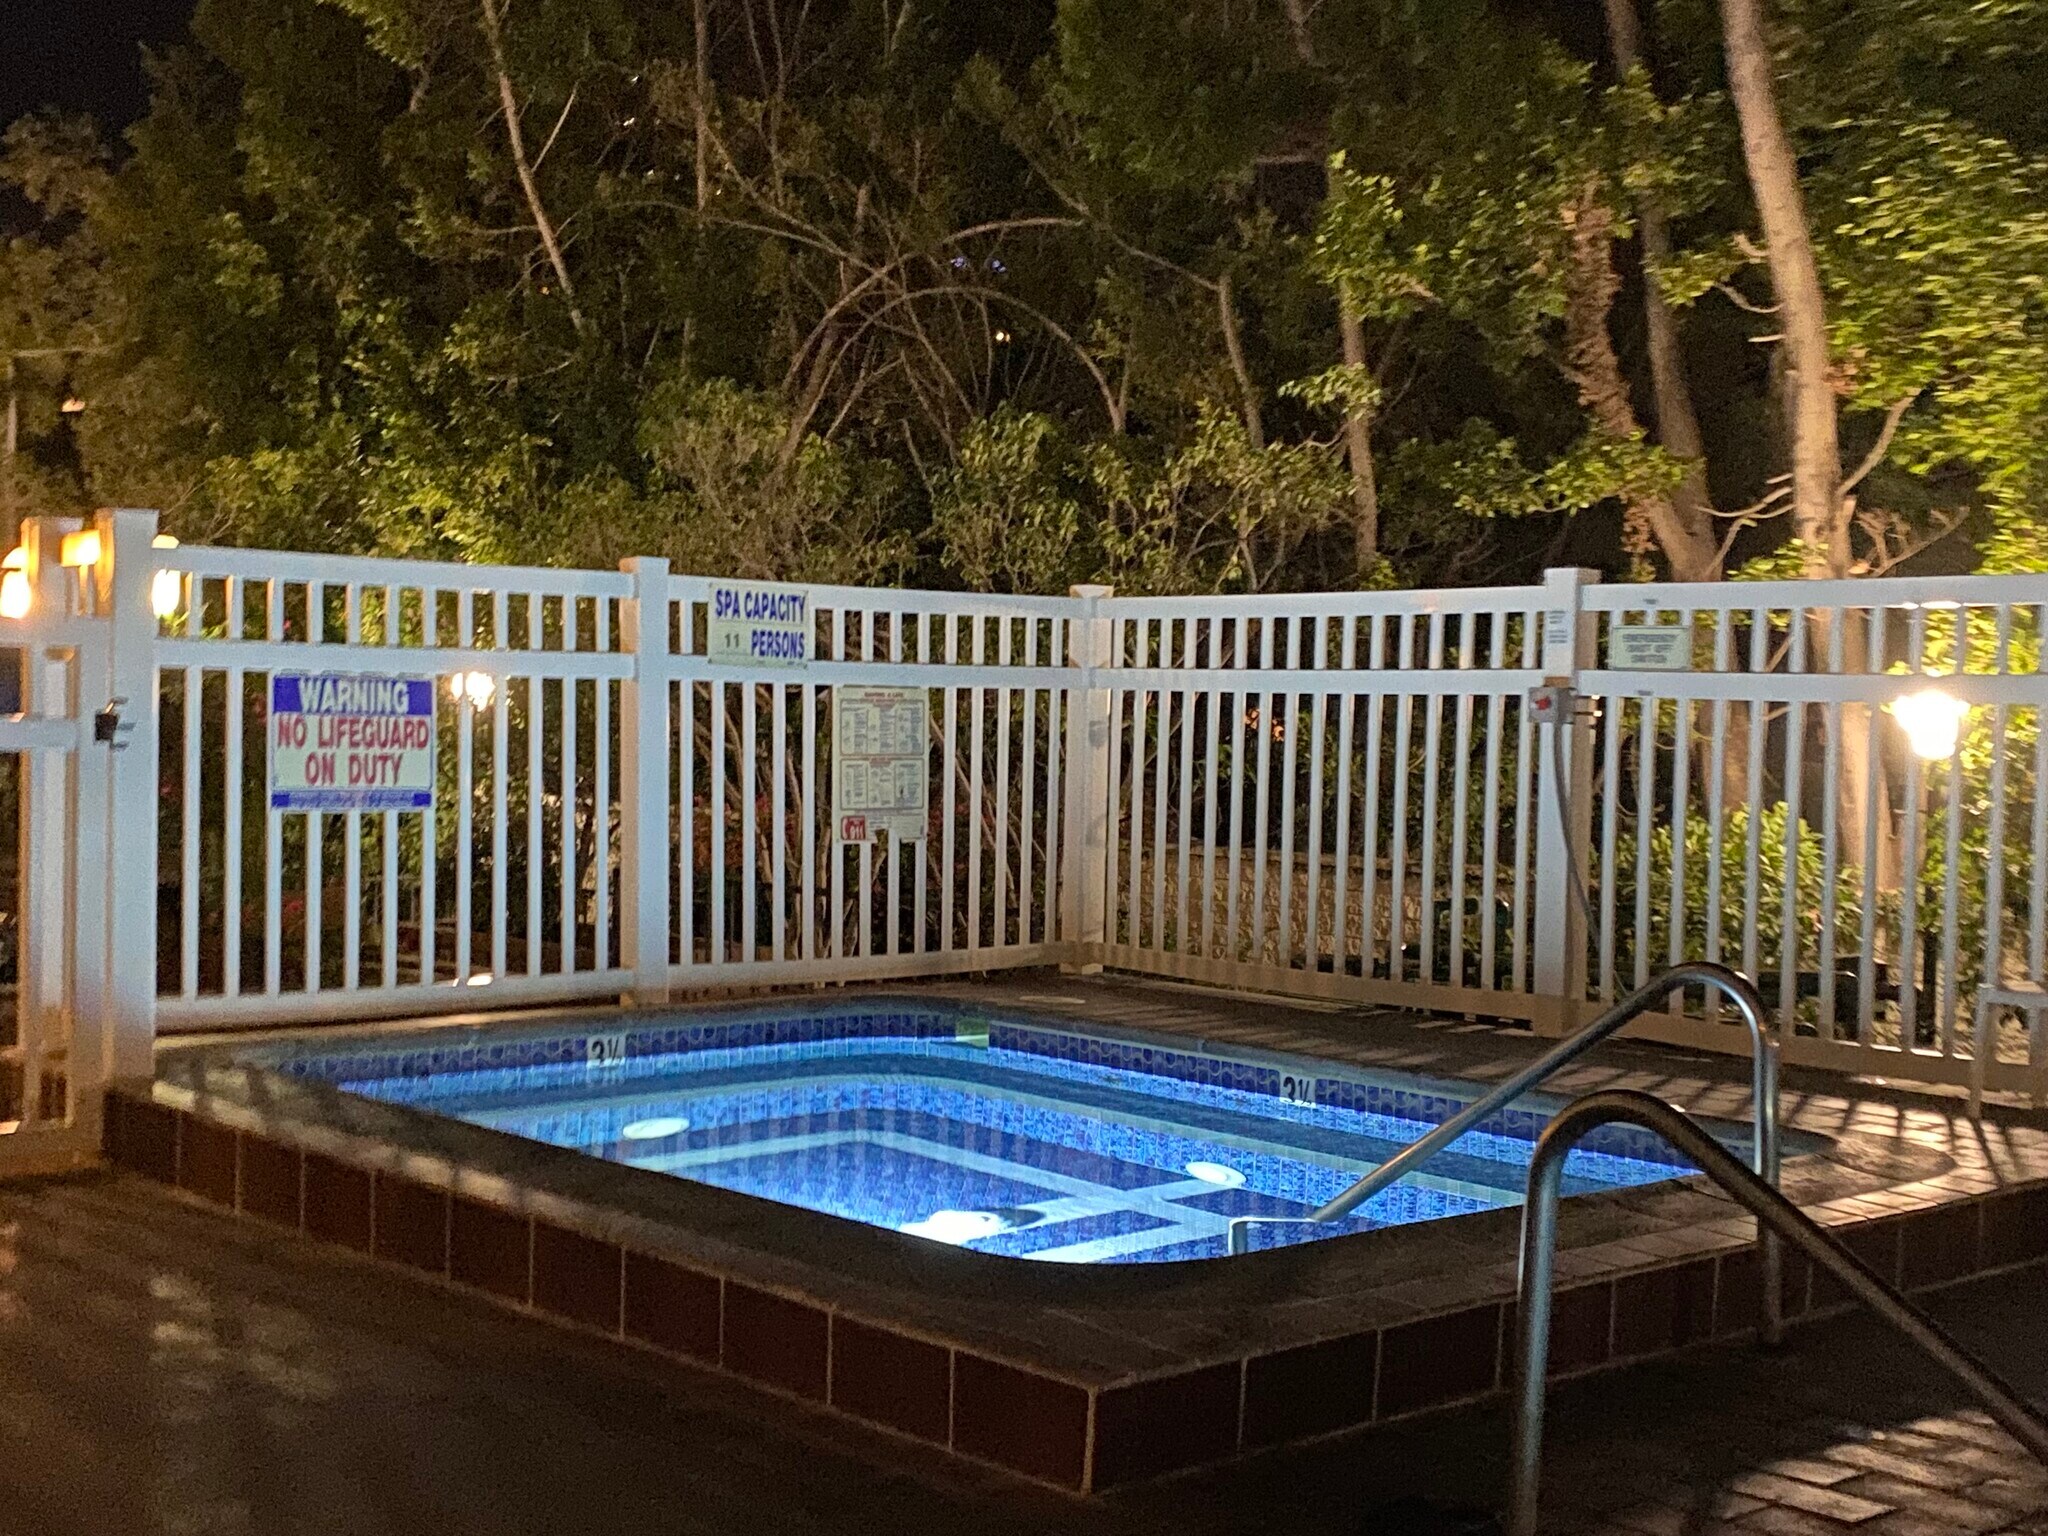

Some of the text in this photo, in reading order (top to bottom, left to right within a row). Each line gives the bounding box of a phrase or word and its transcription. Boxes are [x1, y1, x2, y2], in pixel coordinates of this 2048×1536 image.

[715, 588, 806, 622] SPA CAPACITY
[724, 629, 805, 660] 11 PERSONS
[299, 677, 410, 715] WARNING
[277, 716, 430, 750] NO LIFEGUARD
[304, 751, 403, 785] ON DUTY
